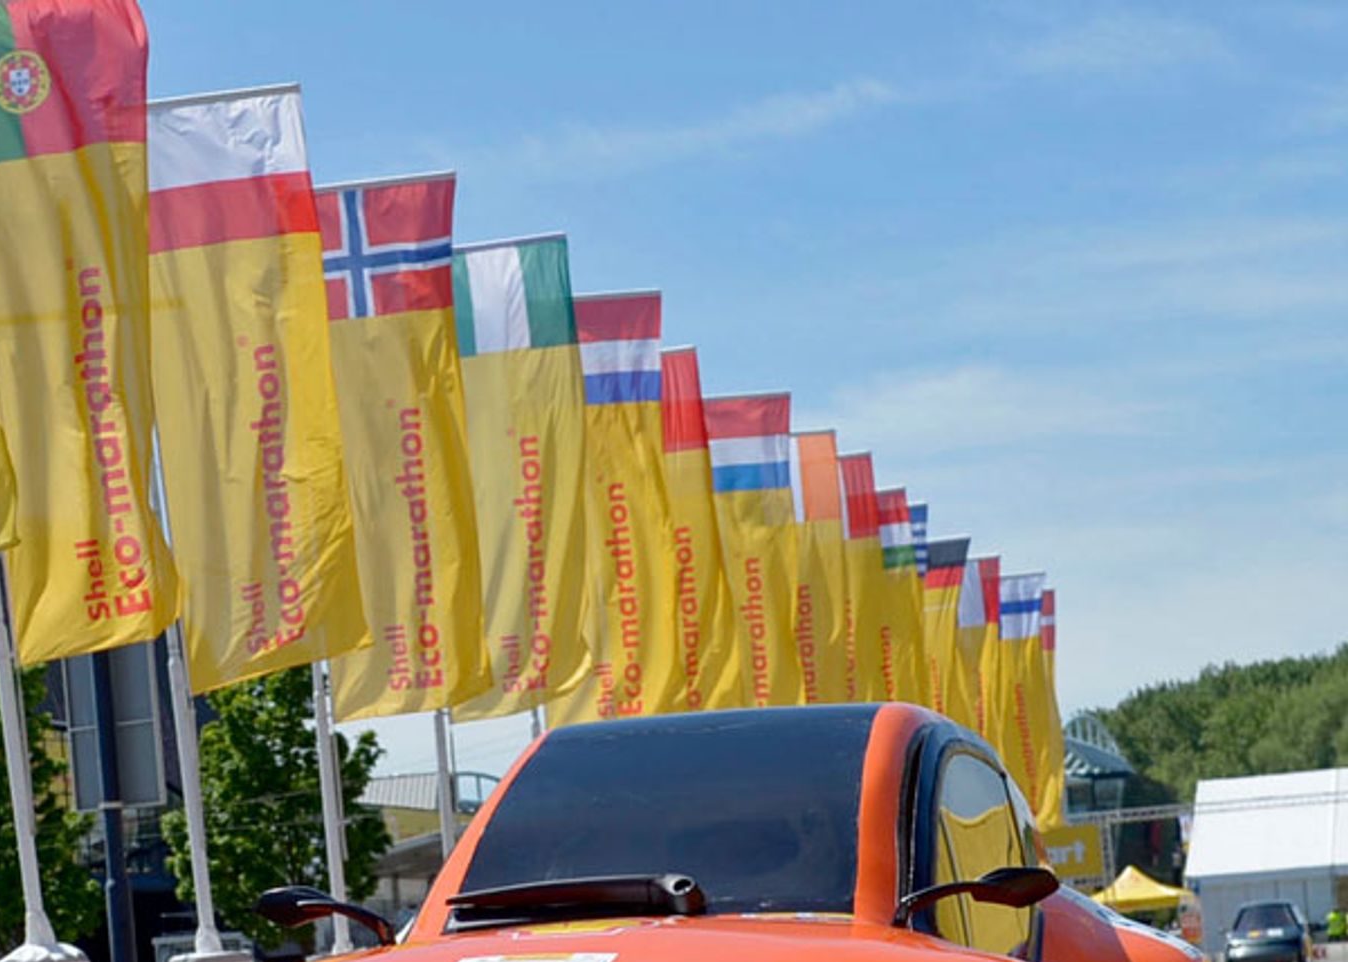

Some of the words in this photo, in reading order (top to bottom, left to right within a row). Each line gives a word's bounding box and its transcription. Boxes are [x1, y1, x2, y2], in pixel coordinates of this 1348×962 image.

[74, 266, 153, 619] Eco-marathon
[250, 343, 306, 651] Eco-marathon
[74, 538, 111, 622] Shell
[241, 581, 271, 656] Shell
[394, 406, 444, 690] Eco-marathon
[512, 434, 552, 692] Eco-marathon
[603, 482, 643, 716] Eco-marathon
[383, 624, 412, 692] Shell
[500, 634, 522, 694] Shell
[593, 661, 615, 718] Shell
